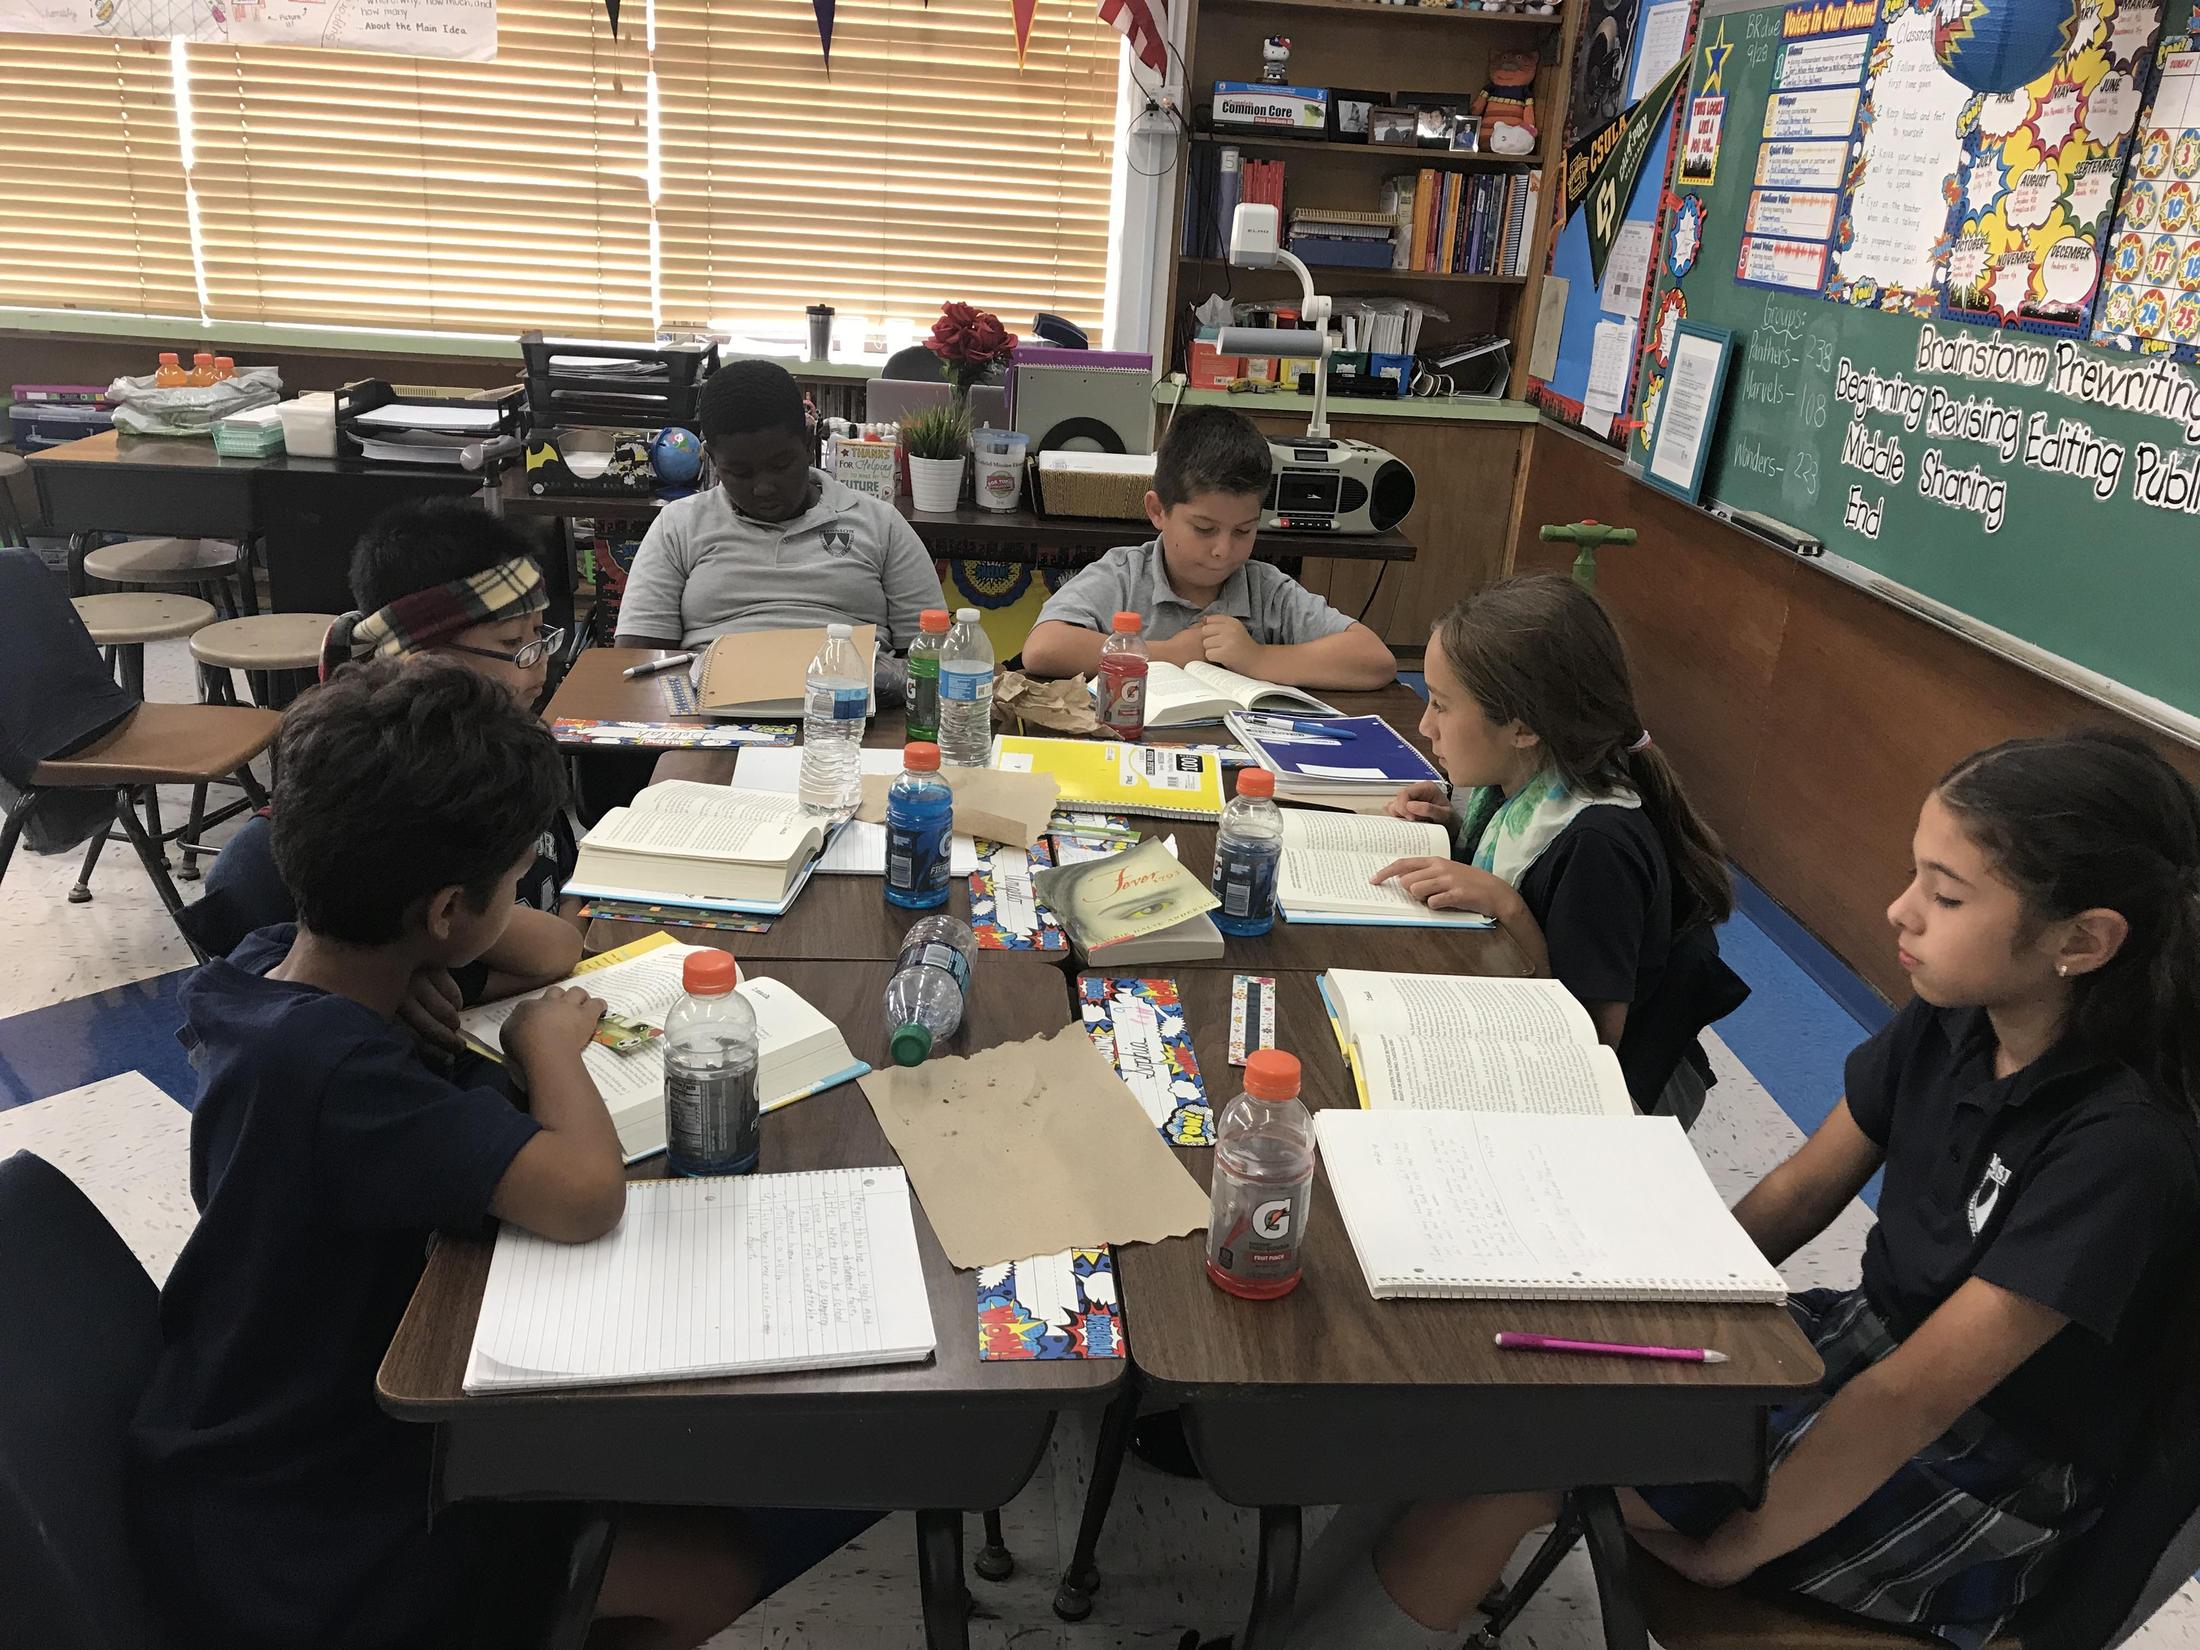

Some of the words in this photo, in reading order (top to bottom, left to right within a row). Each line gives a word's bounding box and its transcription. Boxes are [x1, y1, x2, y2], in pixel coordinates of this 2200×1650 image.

[361, 8, 380, 16] how
[384, 9, 408, 19] many
[1783, 11, 1811, 38] Voices
[1811, 6, 1823, 31] in
[1822, 3, 1843, 32] Our
[1843, 0, 1878, 29] Room!
[365, 22, 390, 31] About
[396, 22, 411, 31] the
[416, 23, 438, 33] Main
[443, 24, 467, 35] Idea
[1896, 61, 1915, 73] Follow
[2053, 85, 2071, 99] MAY
[2100, 78, 2122, 92] JUNE
[1222, 101, 1267, 115] Common
[1269, 105, 1293, 117] Core
[1707, 101, 1724, 116] LOOKS
[1887, 108, 1899, 121] Keep
[1902, 110, 1917, 119] hands
[1920, 112, 1930, 120] and
[1933, 111, 1945, 121] feet
[1590, 114, 1628, 173] CSULA
[1781, 145, 1794, 155] Voice
[1225, 155, 1235, 169] 5
[1929, 153, 1940, 165] and
[1976, 154, 1994, 168] JULY
[2147, 144, 2159, 166] 2
[2181, 143, 2191, 166] 3
[2074, 157, 2123, 175] SEPTEMBER
[2020, 175, 2049, 187] AUGUST
[1778, 194, 1791, 204] Voice
[1904, 202, 1922, 213] teacher
[2135, 196, 2144, 218] 9
[2167, 198, 2183, 219] 10
[1955, 238, 1985, 252] OCTOBER
[2051, 244, 2092, 260] DECEMBER
[1739, 245, 1749, 269] 5
[1751, 240, 1762, 250] Loud
[1762, 242, 1774, 251] Voice
[1996, 251, 2037, 266] NOVEMBER
[2121, 253, 2135, 269] 16
[2153, 251, 2169, 271] 17
[1763, 291, 1807, 346] Groups:
[2140, 304, 2157, 323] 24
[2175, 307, 2194, 330] 25
[1806, 334, 1832, 372] 238
[1917, 326, 2048, 381] Brainstorm
[2056, 343, 2200, 442] Prewriting
[1800, 384, 1826, 428] 108
[1837, 361, 1924, 430] Beginning
[1931, 387, 2020, 460] Revising
[2025, 415, 2123, 497] Editing
[851, 447, 890, 459] THANKS
[840, 460, 854, 469] FOR
[855, 459, 892, 474] Helping
[1843, 424, 1903, 482] Middle
[1921, 451, 2005, 530] Sharing
[840, 480, 880, 492] UTURE
[1846, 487, 1883, 537] End
[1121, 680, 1140, 703] G
[1180, 757, 1198, 772] 100
[1168, 899, 1217, 923] ANDERSON
[1118, 1037, 1166, 1079] Sophia
[1178, 1110, 1208, 1144] POW!
[1252, 1198, 1292, 1240] G
